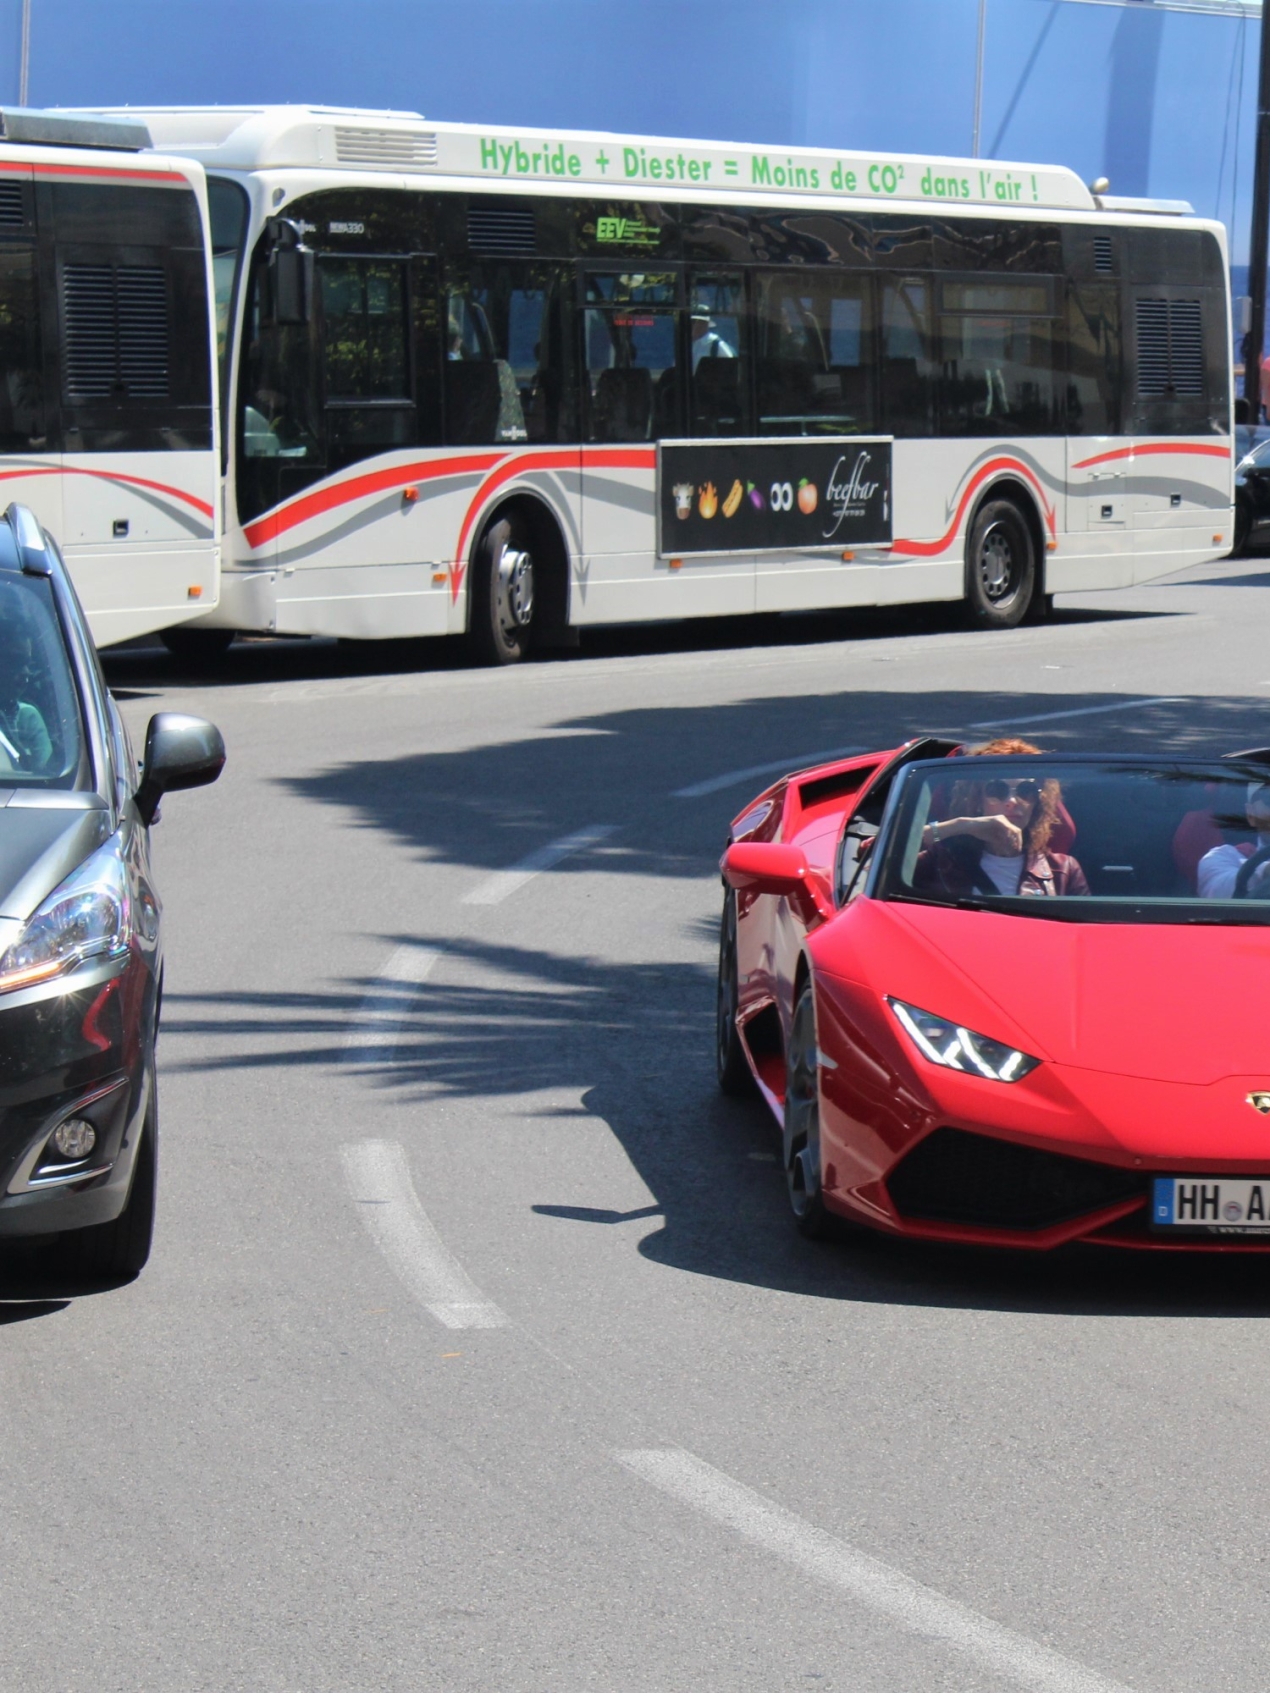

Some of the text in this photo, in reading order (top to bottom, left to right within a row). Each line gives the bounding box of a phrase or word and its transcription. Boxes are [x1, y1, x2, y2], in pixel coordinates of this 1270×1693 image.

[480, 138, 582, 176] Hybride
[596, 149, 610, 174] +
[623, 147, 713, 181] Diester
[724, 160, 739, 176] =
[751, 155, 820, 189] Moins
[830, 160, 857, 191] de
[921, 167, 970, 198] dans
[979, 170, 1022, 201] l'air
[1031, 174, 1039, 202] !
[597, 216, 627, 239] EEV
[822, 450, 880, 538] beefbar
[1178, 1184, 1220, 1220] HH
